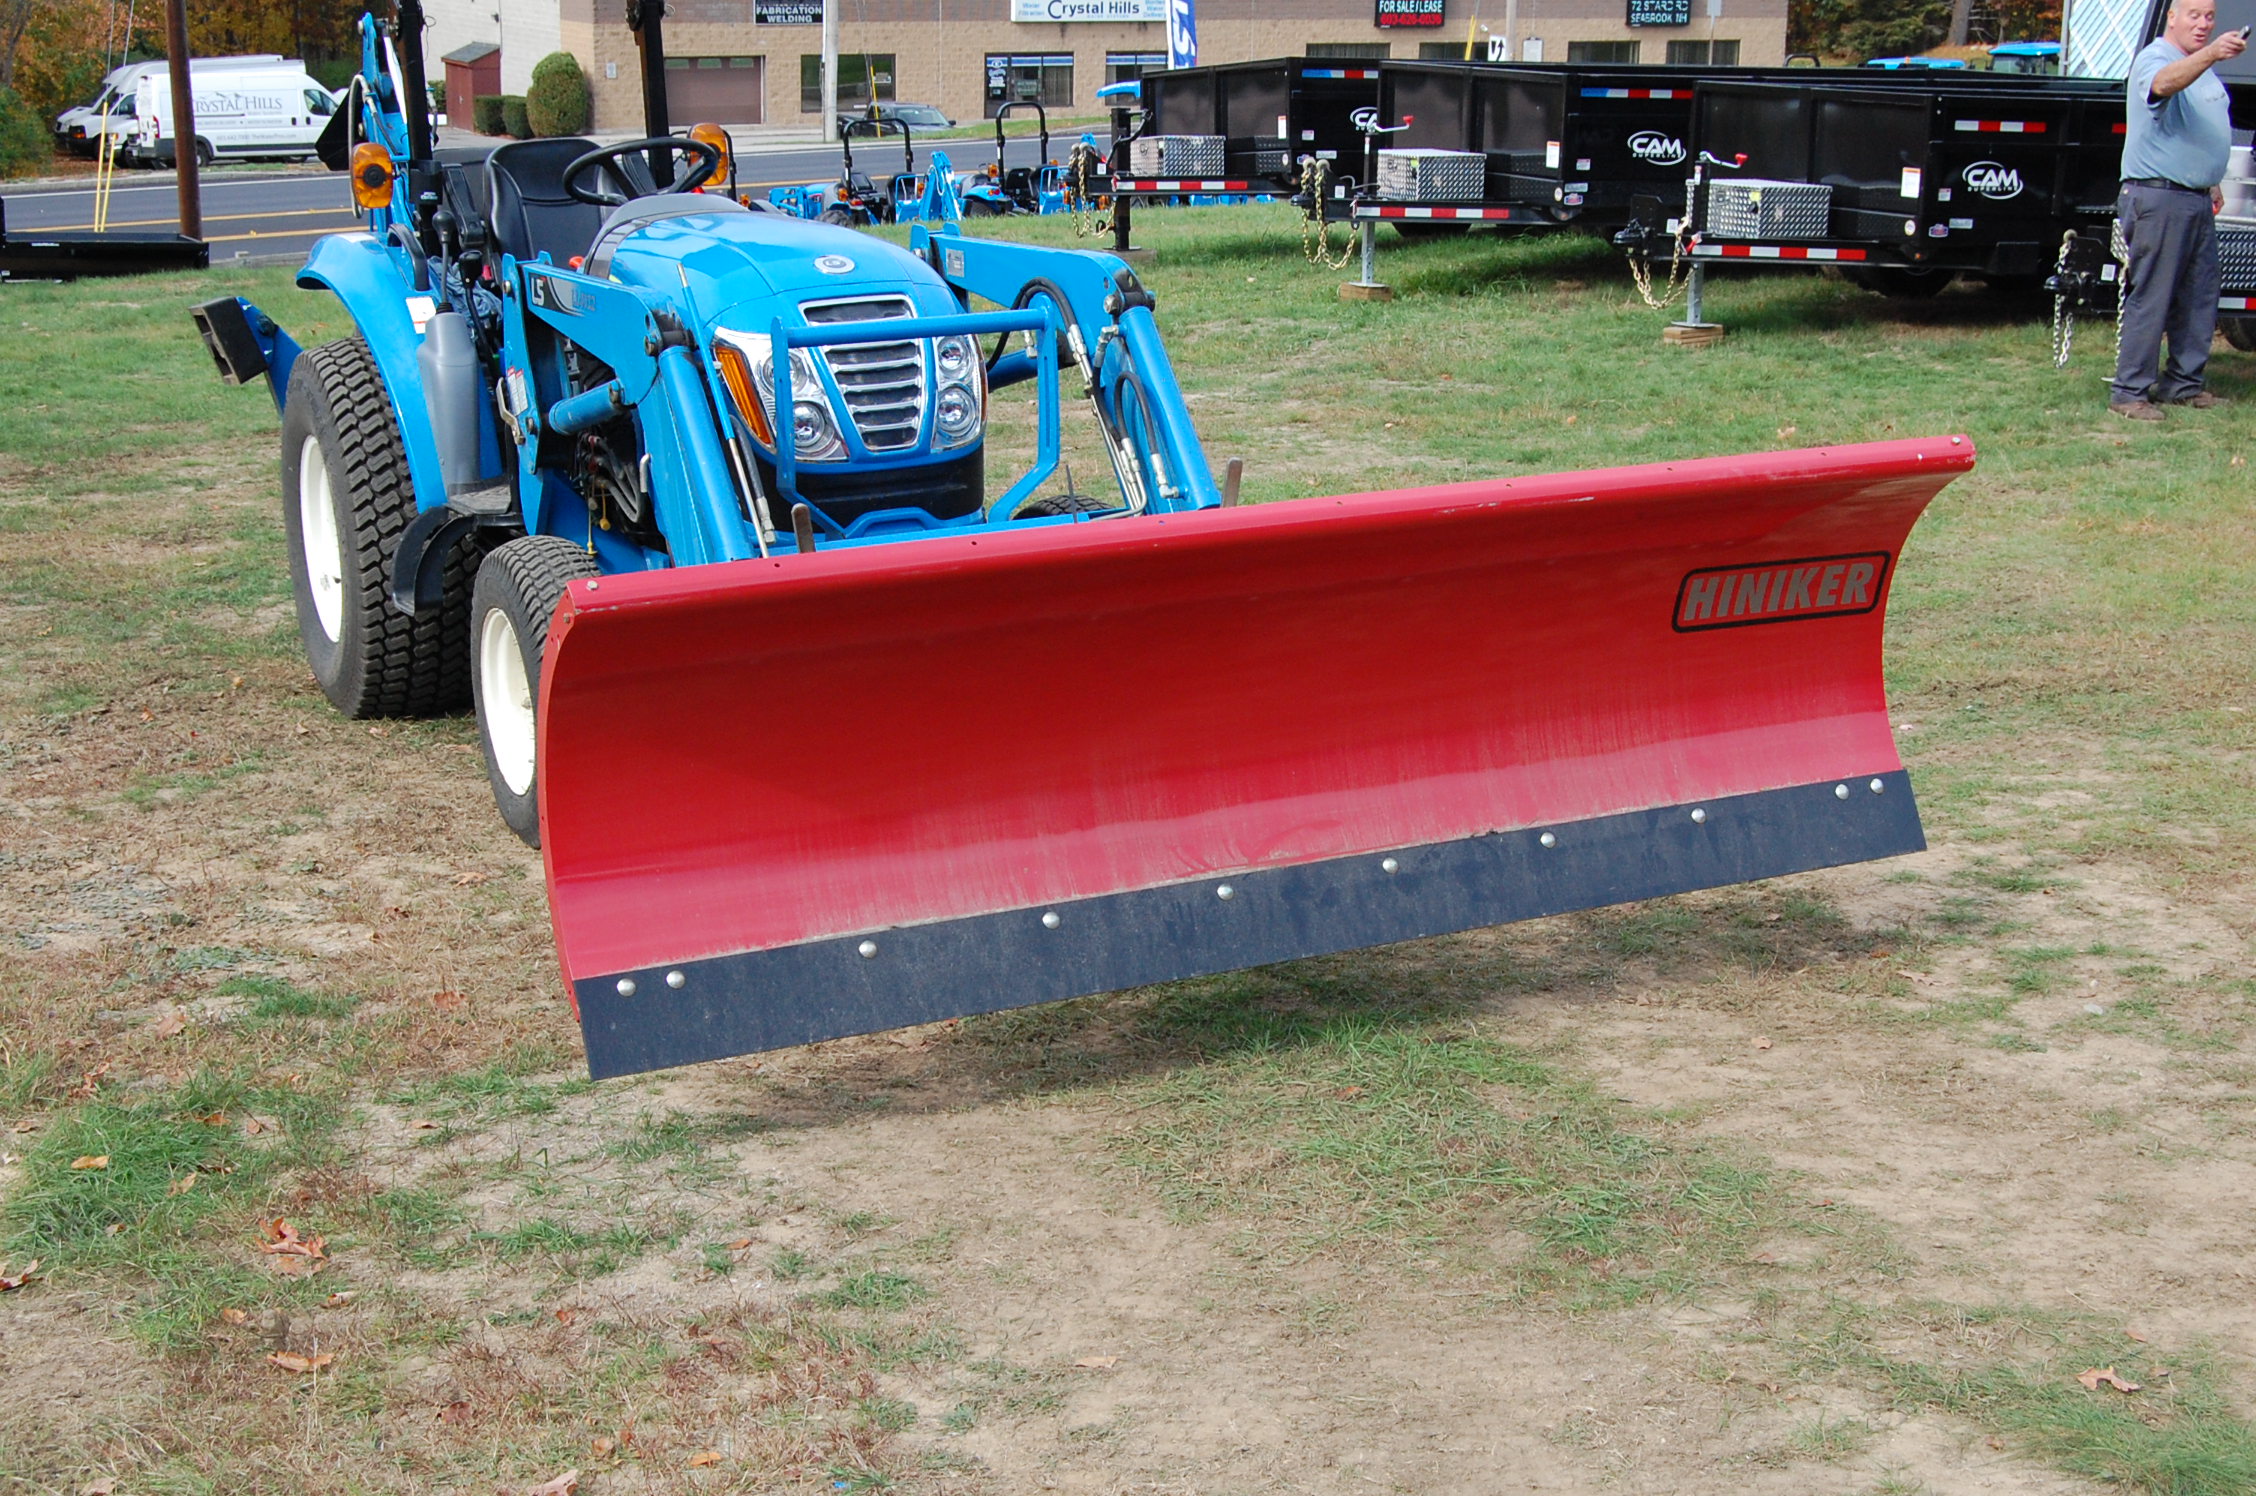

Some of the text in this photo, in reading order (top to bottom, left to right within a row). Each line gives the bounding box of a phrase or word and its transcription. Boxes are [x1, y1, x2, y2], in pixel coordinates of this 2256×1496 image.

[756, 6, 822, 15] FABRICATION
[1048, 0, 1140, 19] Crystal Hills
[1379, 0, 1396, 13] FOR
[1631, 1, 1642, 11] 72
[767, 15, 813, 23] WELDING
[195, 98, 243, 113] RYSTAL
[1632, 137, 1682, 156] CAM
[1967, 168, 2019, 188] CAM
[531, 277, 545, 306] LS
[1683, 562, 1875, 622] HINIKER
